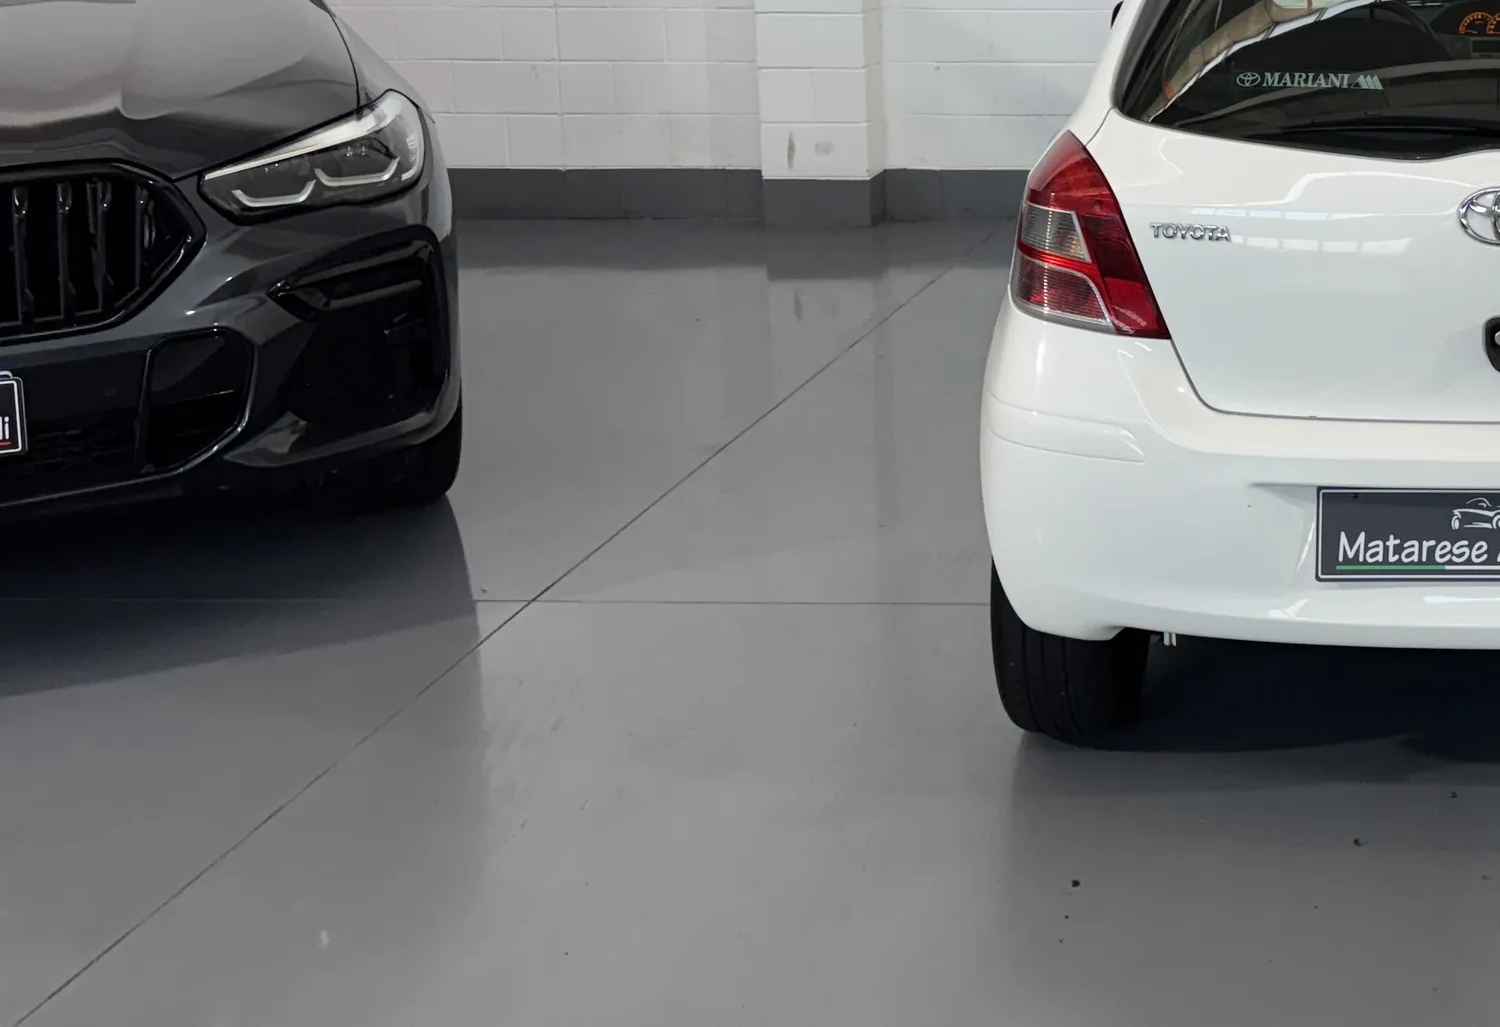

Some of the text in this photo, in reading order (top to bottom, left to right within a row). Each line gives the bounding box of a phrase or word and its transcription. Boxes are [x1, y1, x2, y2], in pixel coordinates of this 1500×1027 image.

[1262, 72, 1350, 89] MARIANI
[1149, 222, 1232, 242] TOYOTA
[1337, 530, 1489, 564] Matarese
